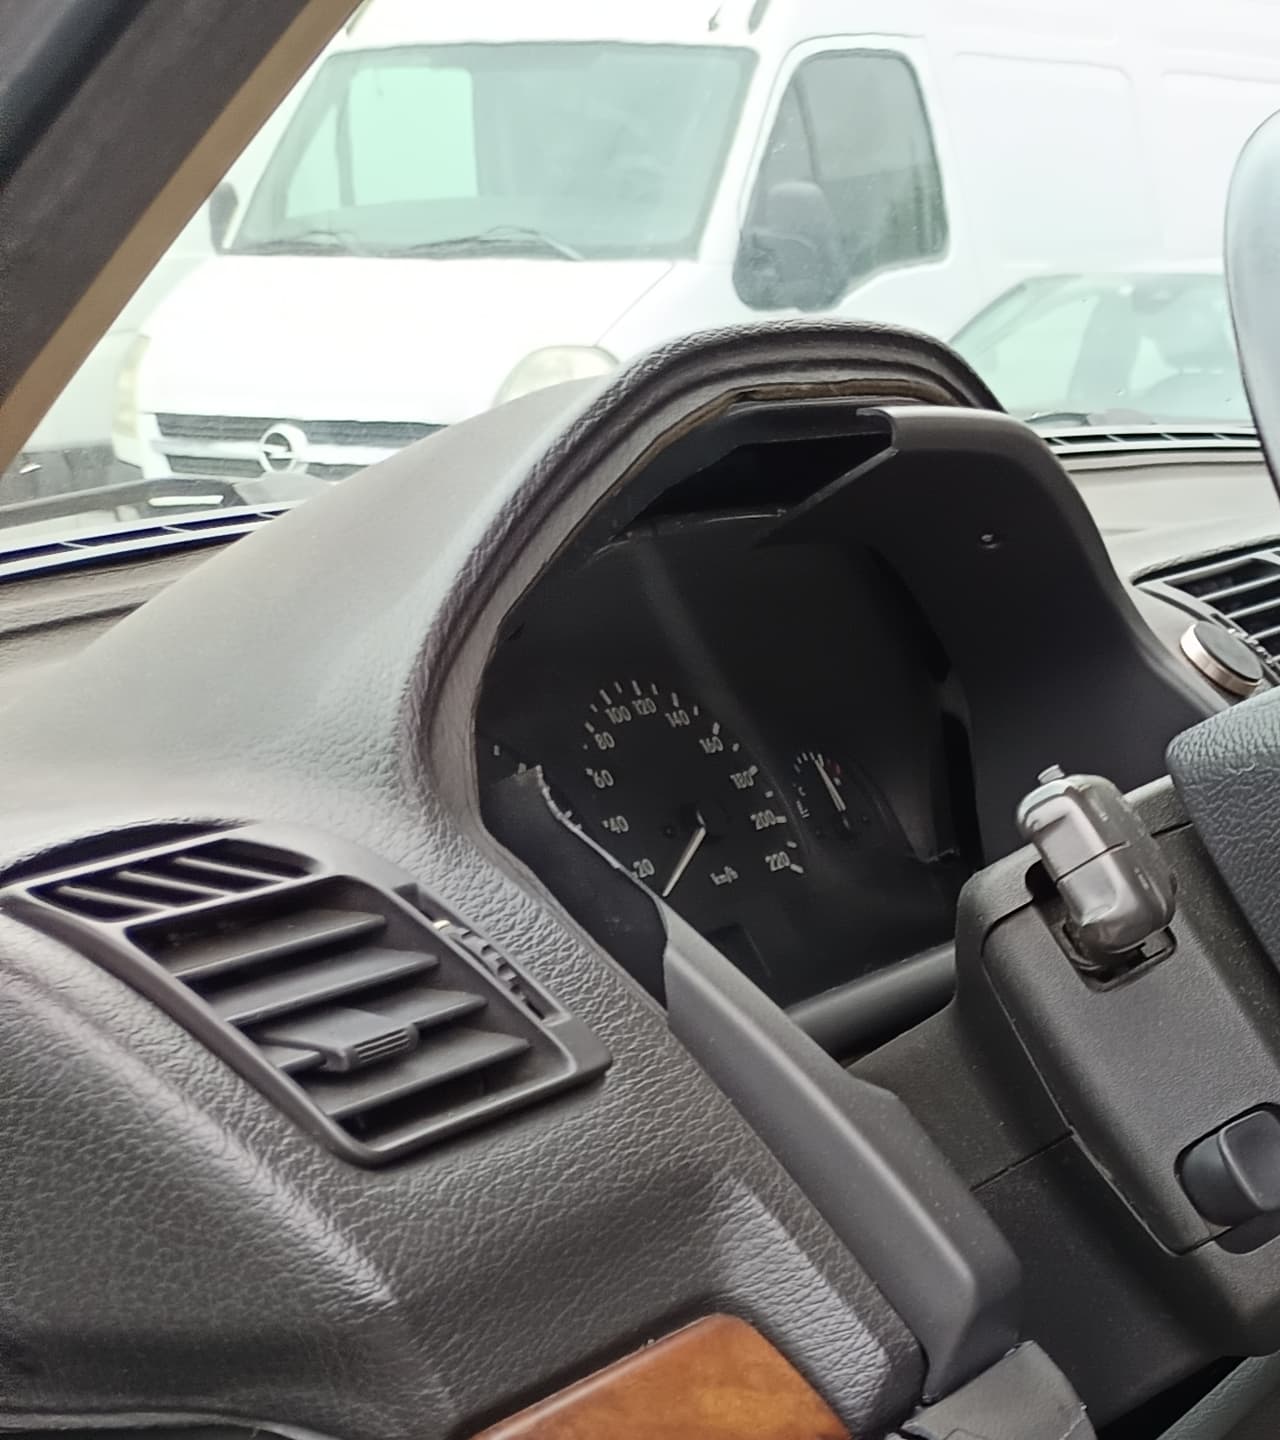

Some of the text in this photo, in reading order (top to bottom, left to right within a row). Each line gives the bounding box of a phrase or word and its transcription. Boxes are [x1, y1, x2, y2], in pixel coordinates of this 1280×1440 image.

[605, 706, 632, 724] 100
[632, 697, 657, 715] 120
[665, 709, 690, 728] 140
[594, 731, 615, 750] 80
[699, 735, 724, 754] 160
[593, 770, 614, 788] 60
[609, 815, 629, 833] 40
[750, 809, 776, 830] 200
[632, 858, 655, 879] 20
[765, 850, 790, 872] 220
